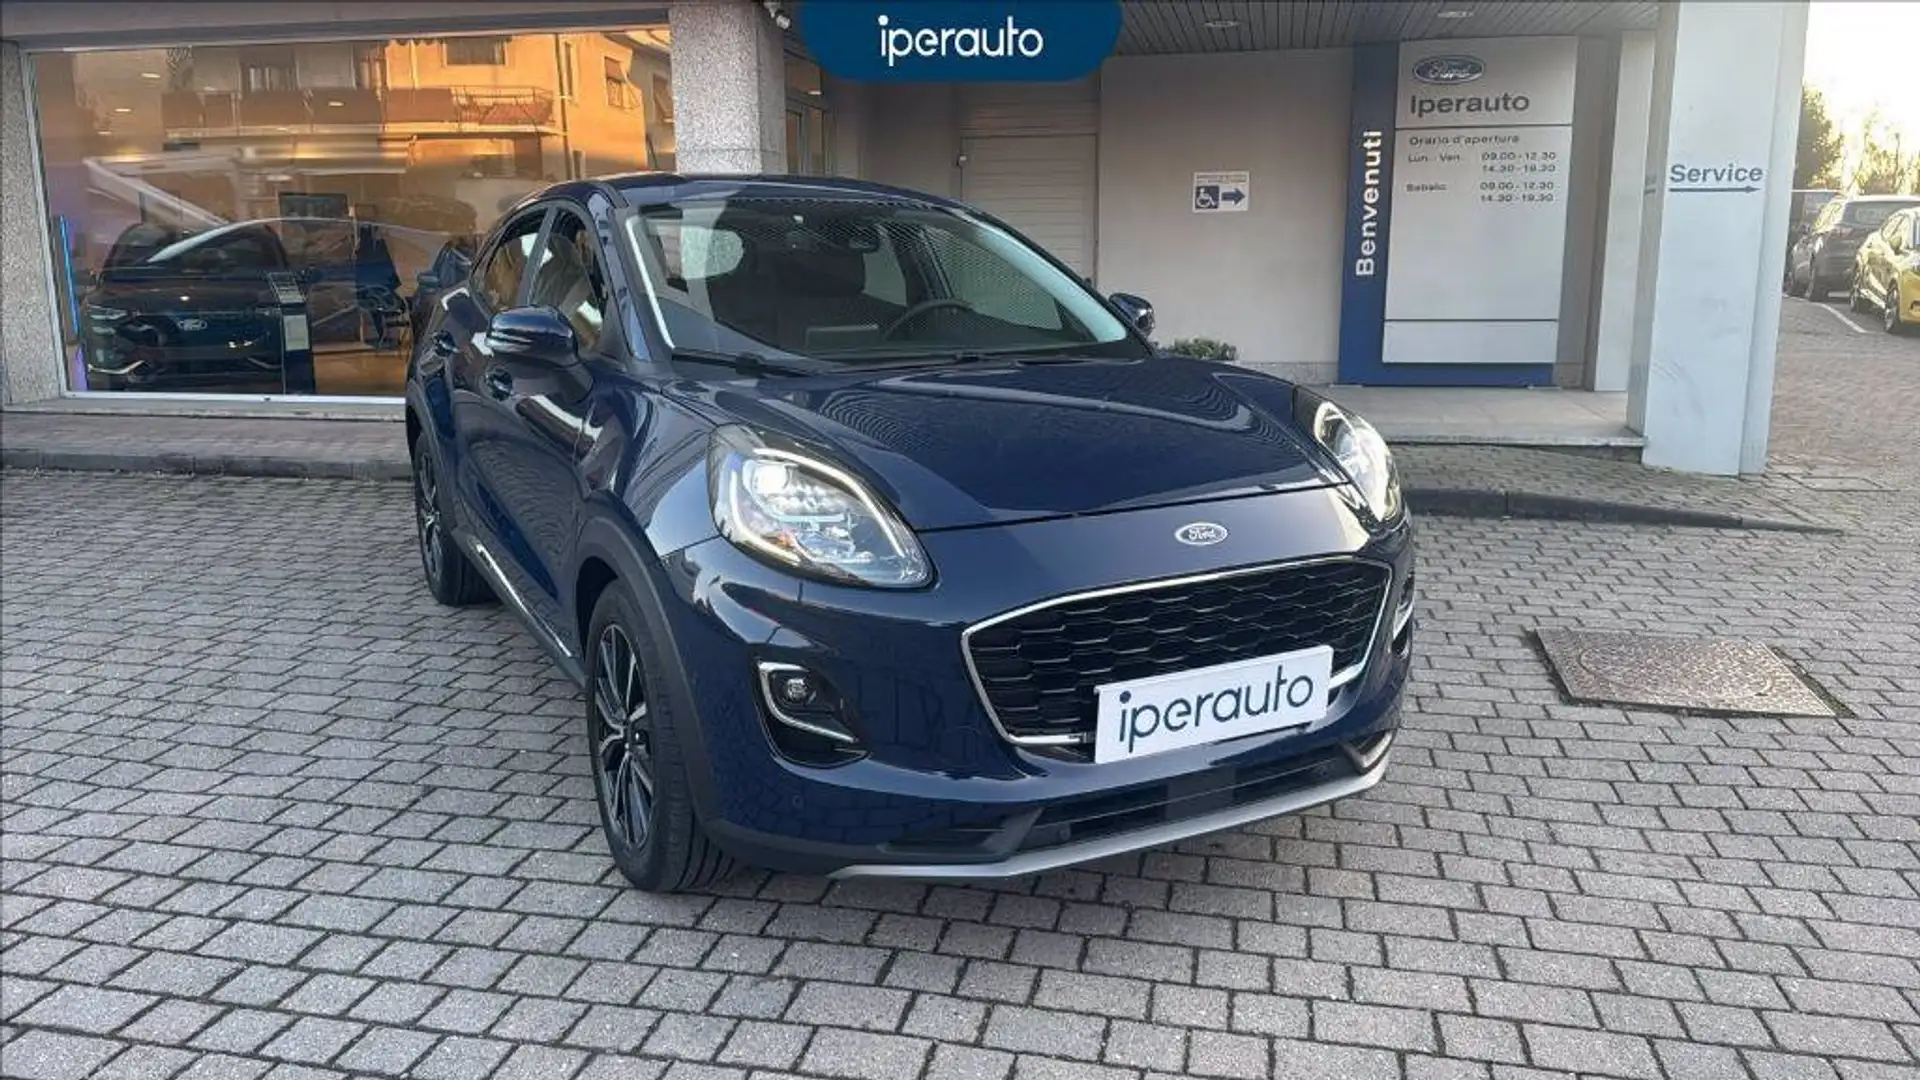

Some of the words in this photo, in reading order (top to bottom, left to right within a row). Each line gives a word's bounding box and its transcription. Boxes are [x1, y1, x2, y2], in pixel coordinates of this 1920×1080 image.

[1410, 92, 1531, 118] Iperauto
[1670, 163, 1763, 183] Service
[1356, 130, 1382, 276] Benvenuti
[1119, 665, 1313, 753] iperauto
